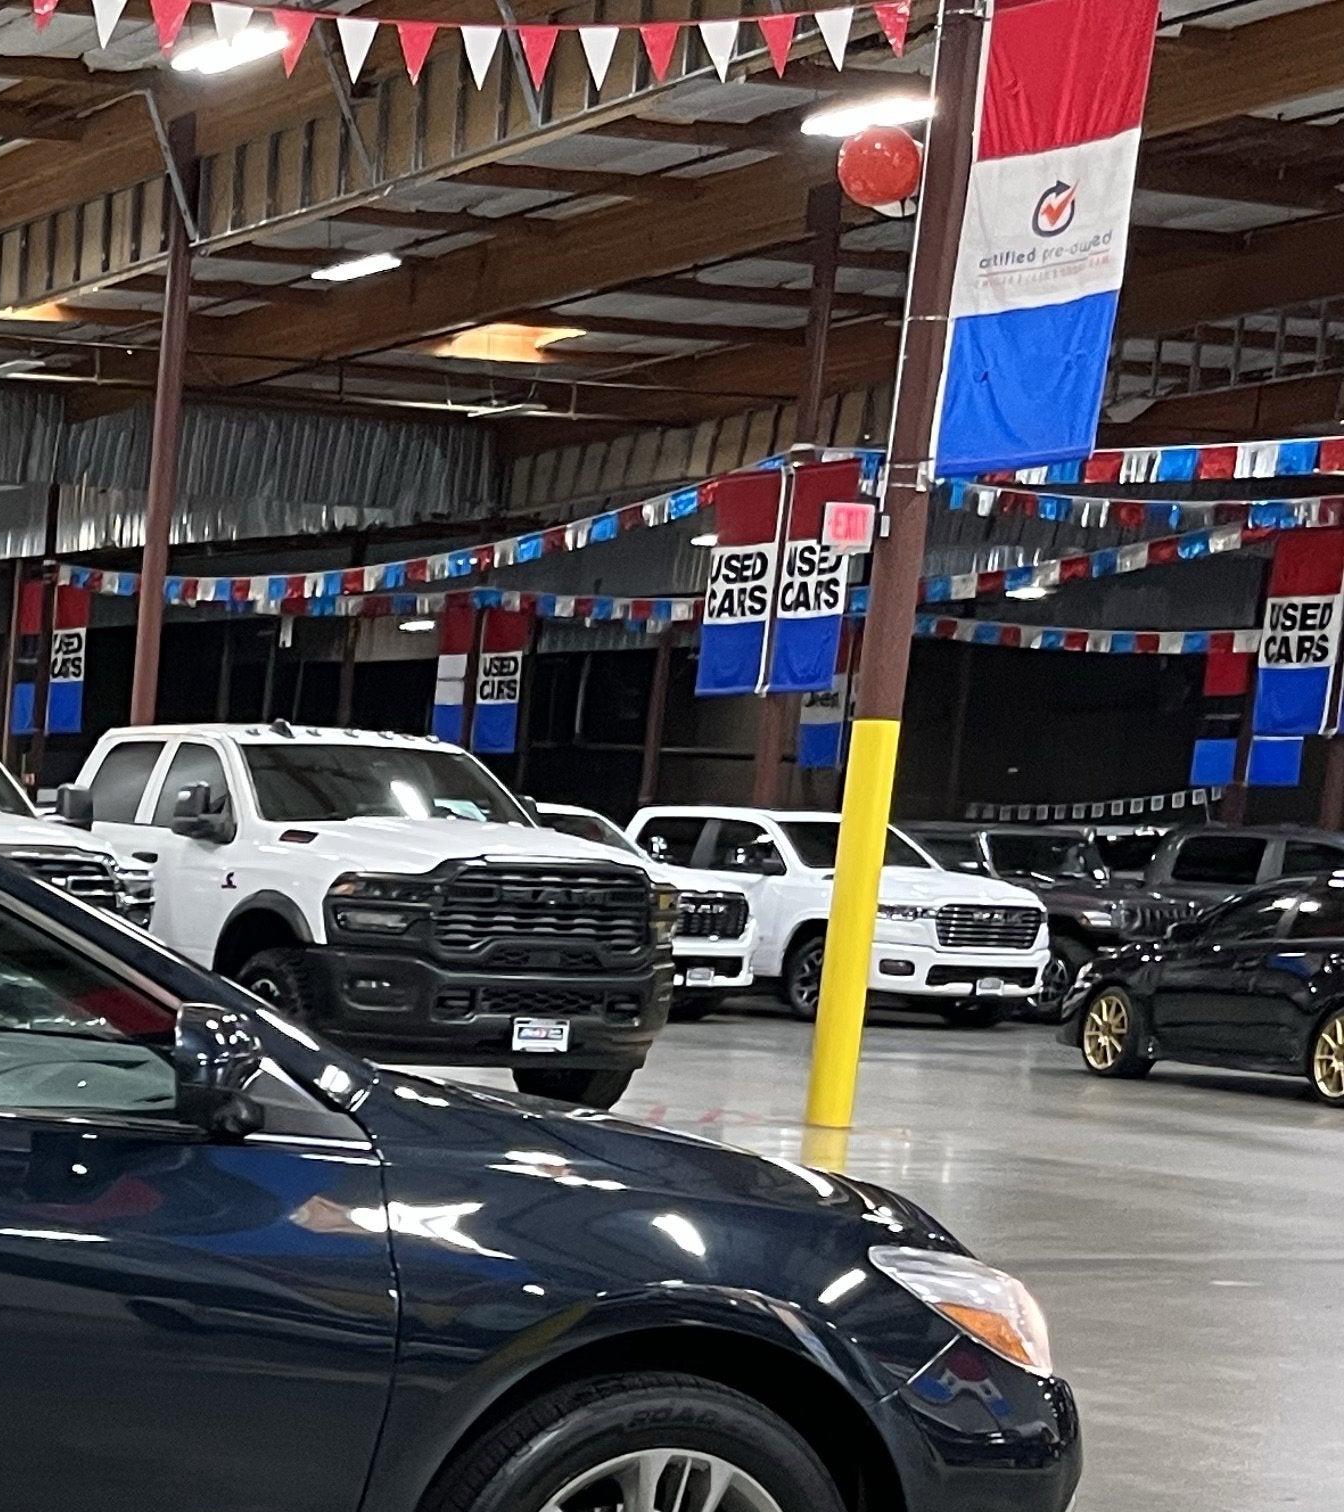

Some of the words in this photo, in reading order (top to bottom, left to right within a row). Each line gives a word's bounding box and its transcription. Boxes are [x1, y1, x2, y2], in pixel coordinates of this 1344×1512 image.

[712, 552, 769, 585] USED
[708, 584, 767, 617] CARS
[781, 577, 840, 612] CARS
[1270, 603, 1333, 632] USED
[1264, 633, 1329, 664] CARS
[483, 656, 519, 677] USED
